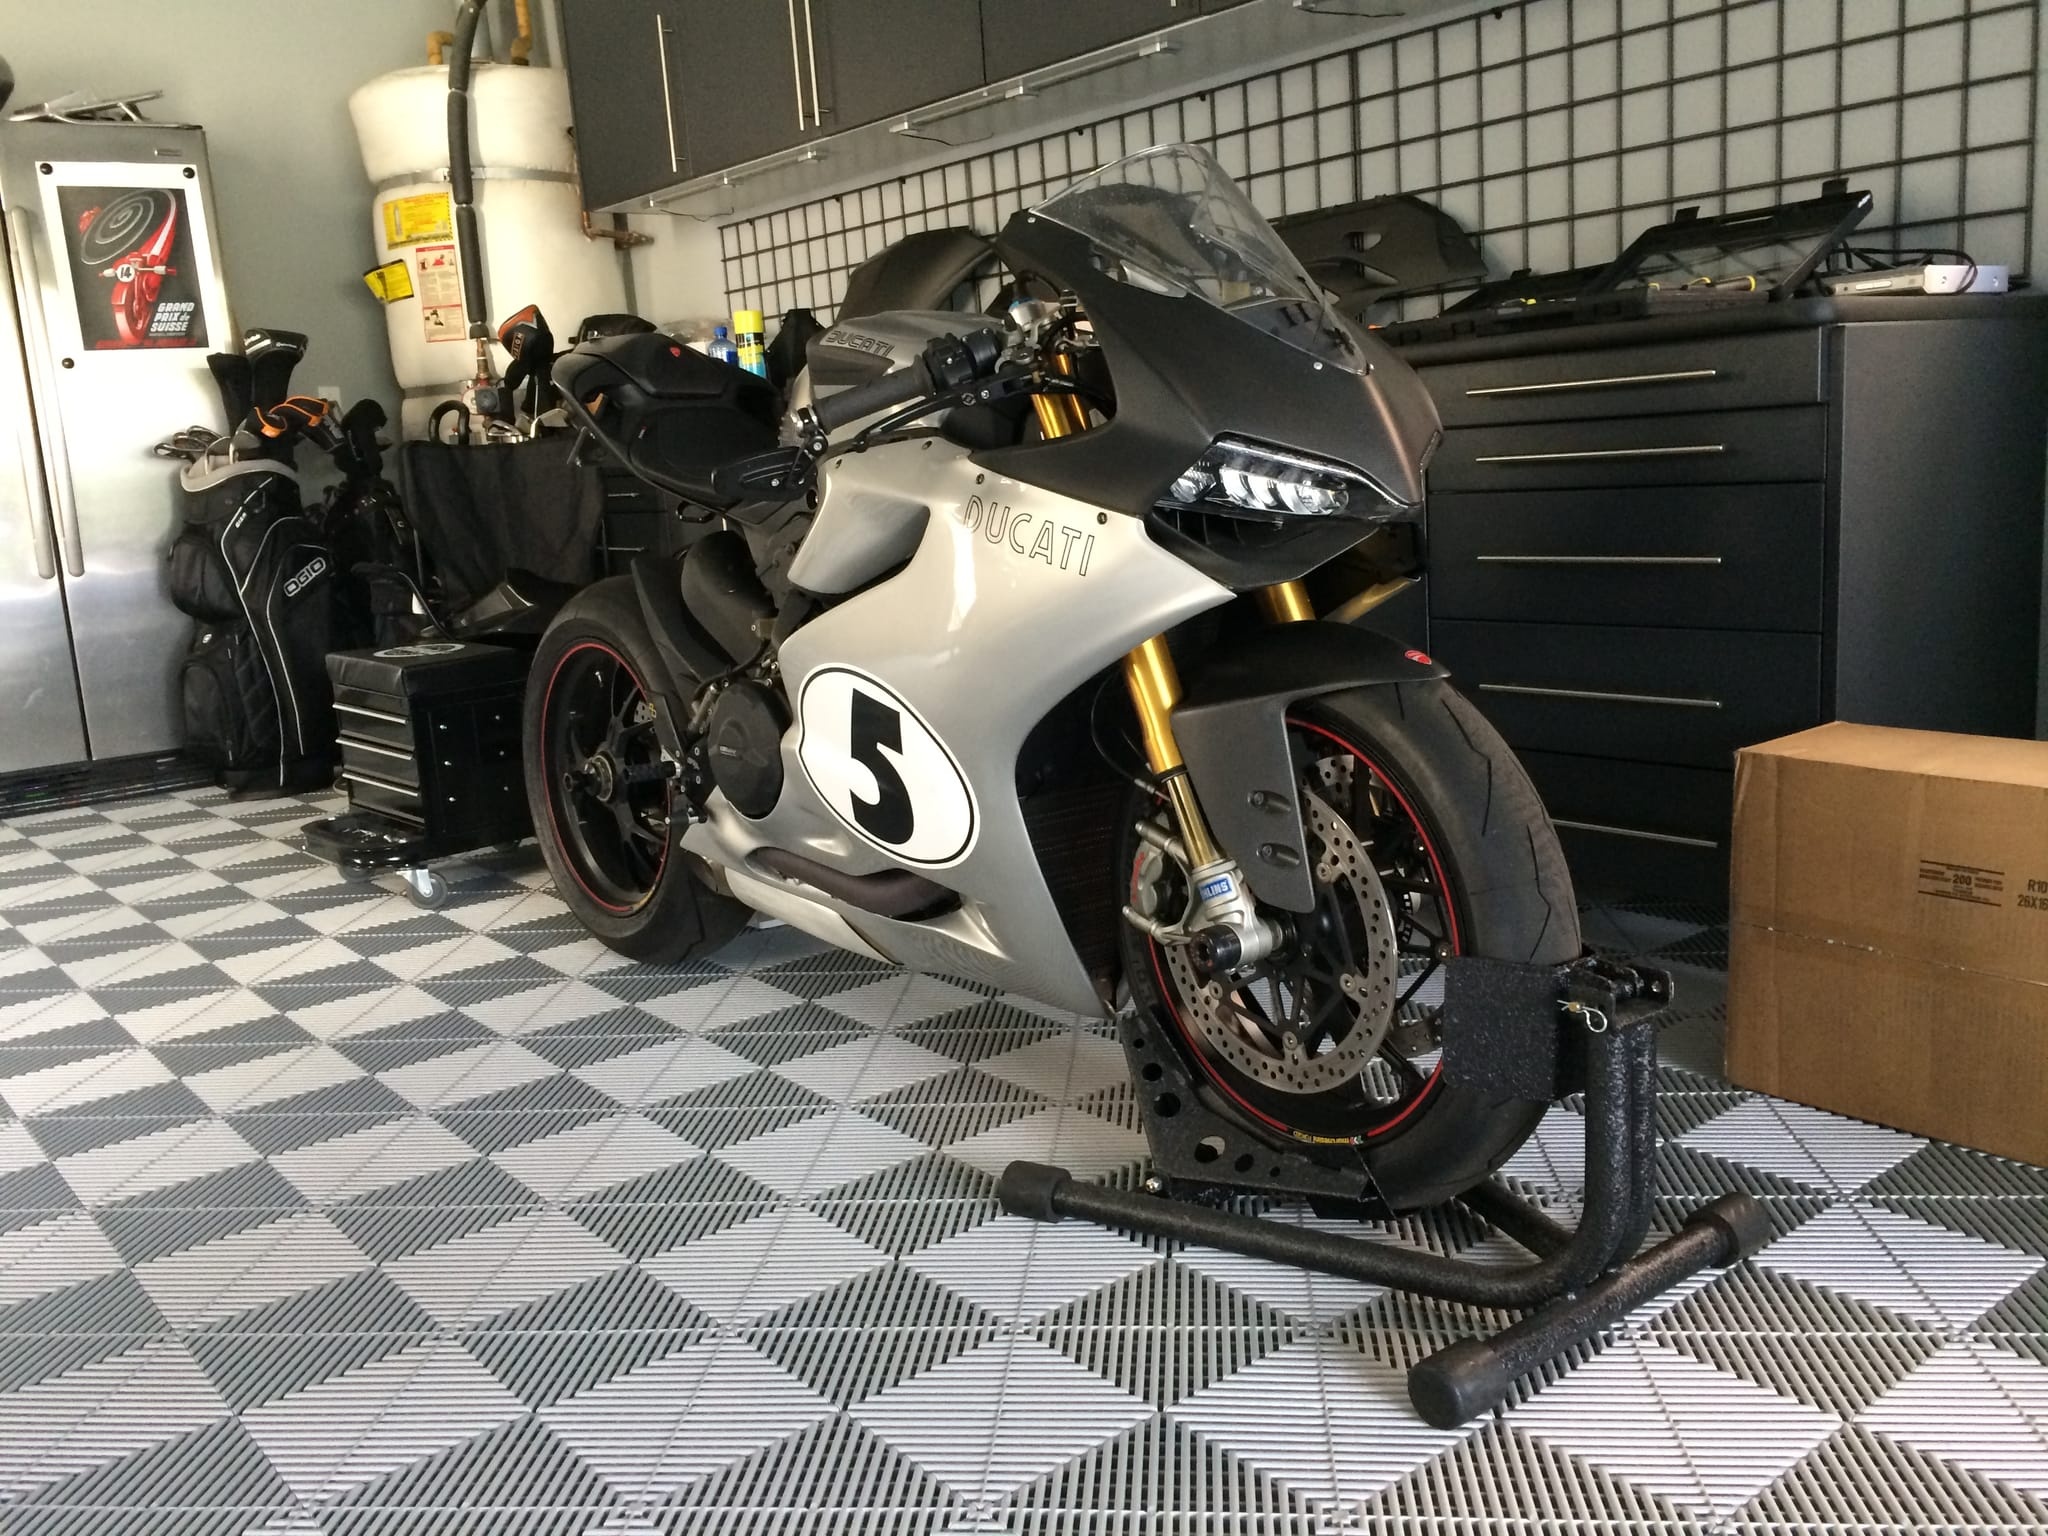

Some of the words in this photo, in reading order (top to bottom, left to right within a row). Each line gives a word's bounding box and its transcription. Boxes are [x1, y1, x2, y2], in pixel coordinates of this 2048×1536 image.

[120, 267, 133, 279] 14
[158, 302, 195, 312] GRAND
[153, 312, 180, 321] PRIX
[179, 312, 191, 321] de
[150, 322, 189, 332] SUISSE
[825, 330, 895, 357] DUCATI
[964, 495, 1095, 576] DUCATI
[283, 557, 326, 597] OGIO
[849, 687, 915, 845] 5
[1952, 873, 1972, 886] 200
